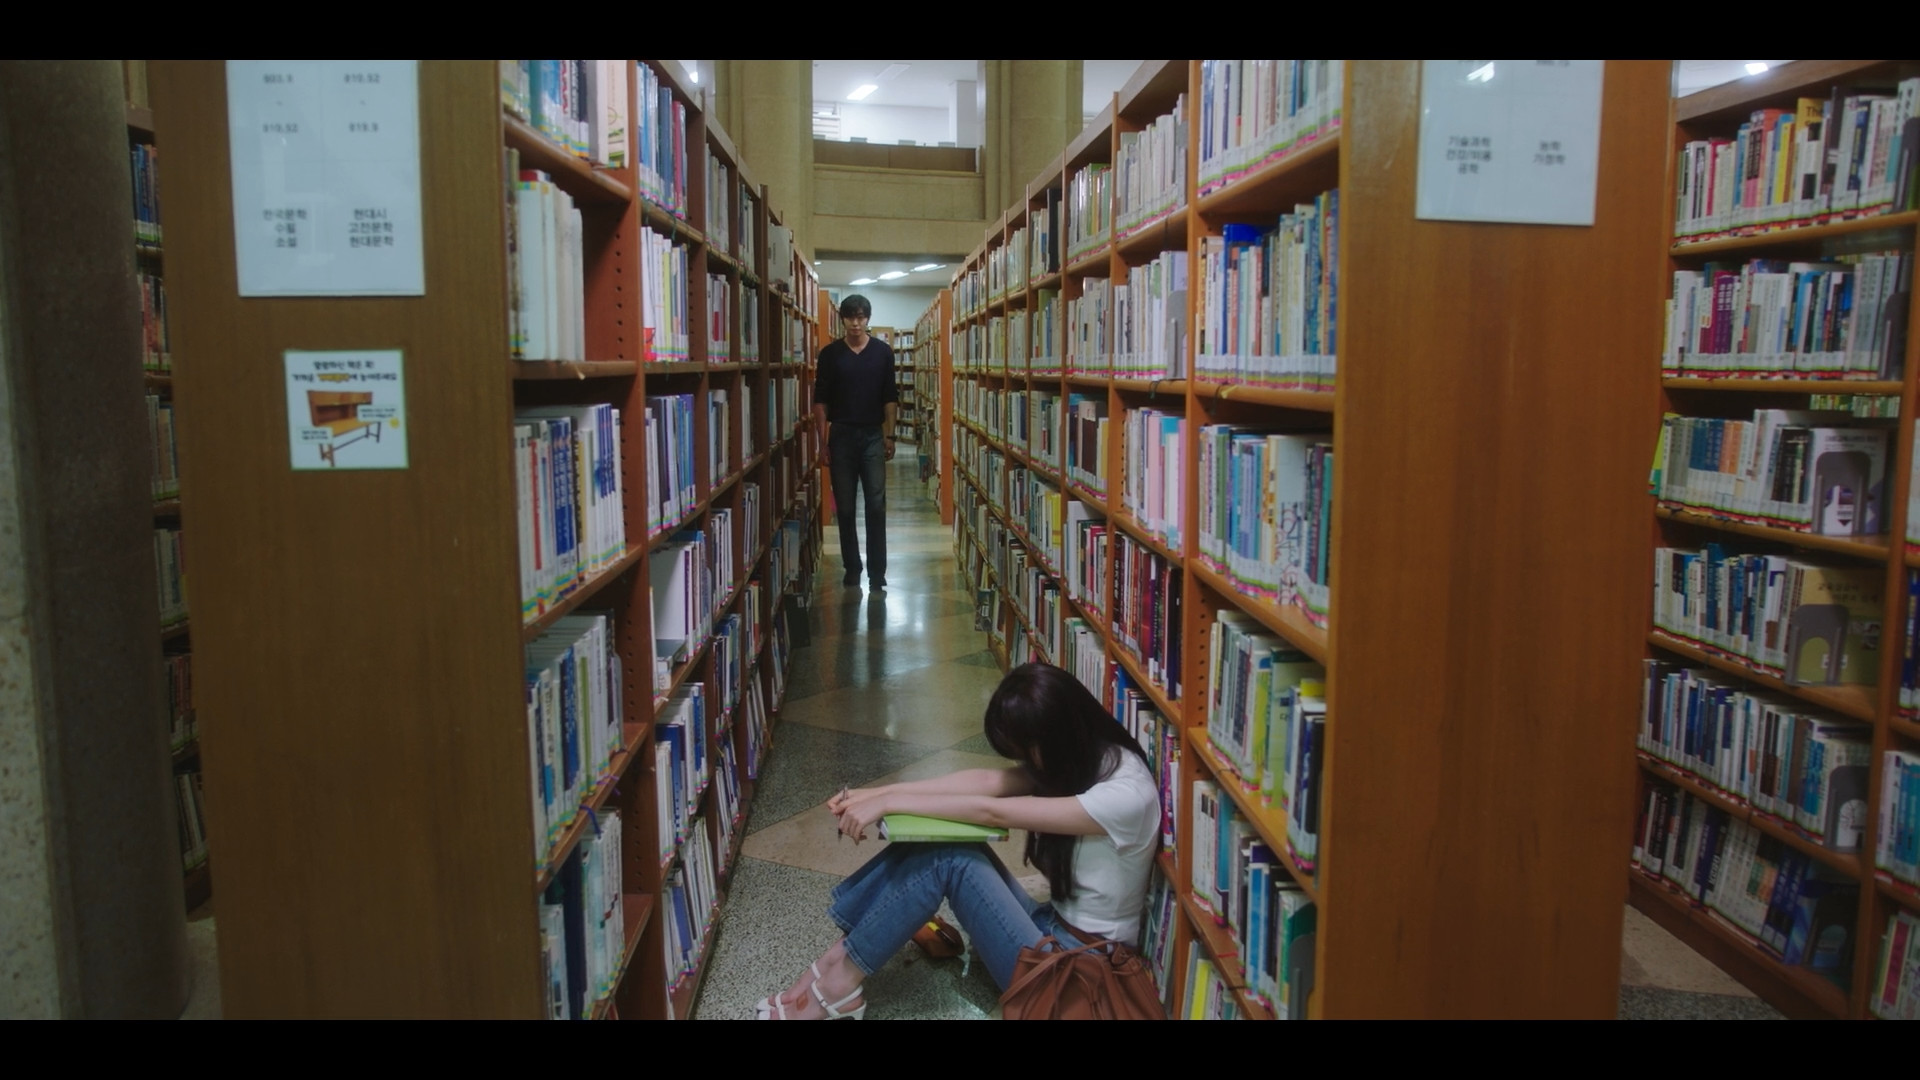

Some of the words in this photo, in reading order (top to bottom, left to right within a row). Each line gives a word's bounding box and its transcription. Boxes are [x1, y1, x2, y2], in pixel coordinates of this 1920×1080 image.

[262, 209, 307, 220] 한국문학
[353, 208, 387, 220] 현대시
[275, 222, 296, 234] 수필
[348, 222, 393, 233] 고전문학
[275, 236, 298, 248] 소설
[349, 235, 394, 247] 현대문학
